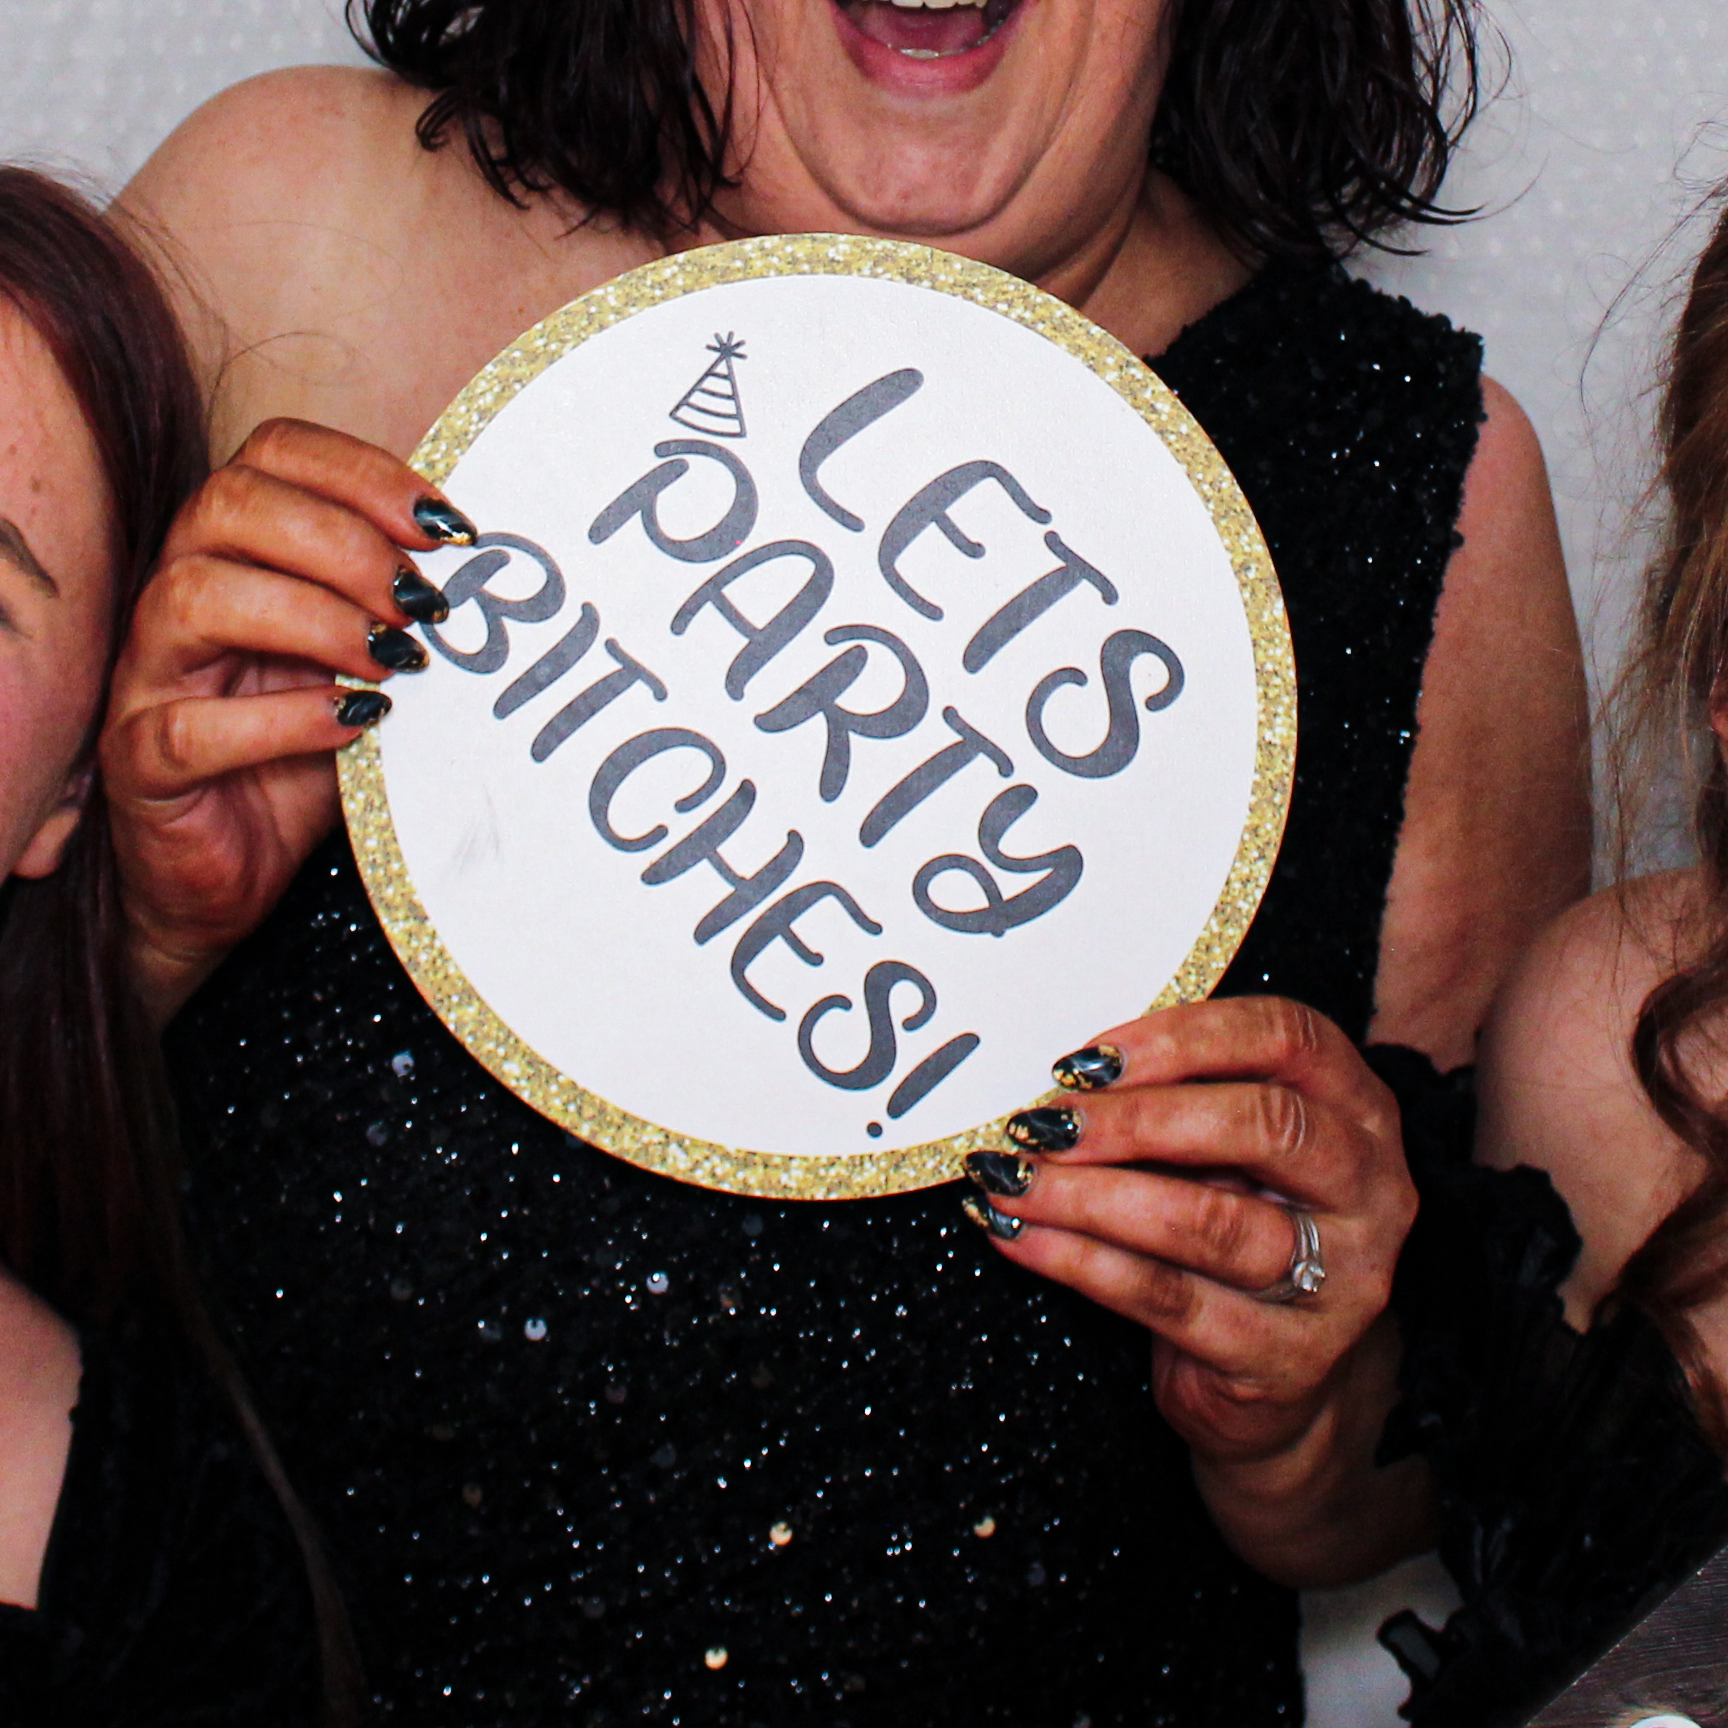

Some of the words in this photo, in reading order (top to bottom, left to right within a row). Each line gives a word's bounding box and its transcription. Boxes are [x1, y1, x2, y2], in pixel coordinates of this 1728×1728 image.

[587, 439, 1084, 939] PARTY
[798, 367, 1185, 780] LETS
[419, 531, 981, 1138] BITCHES!
